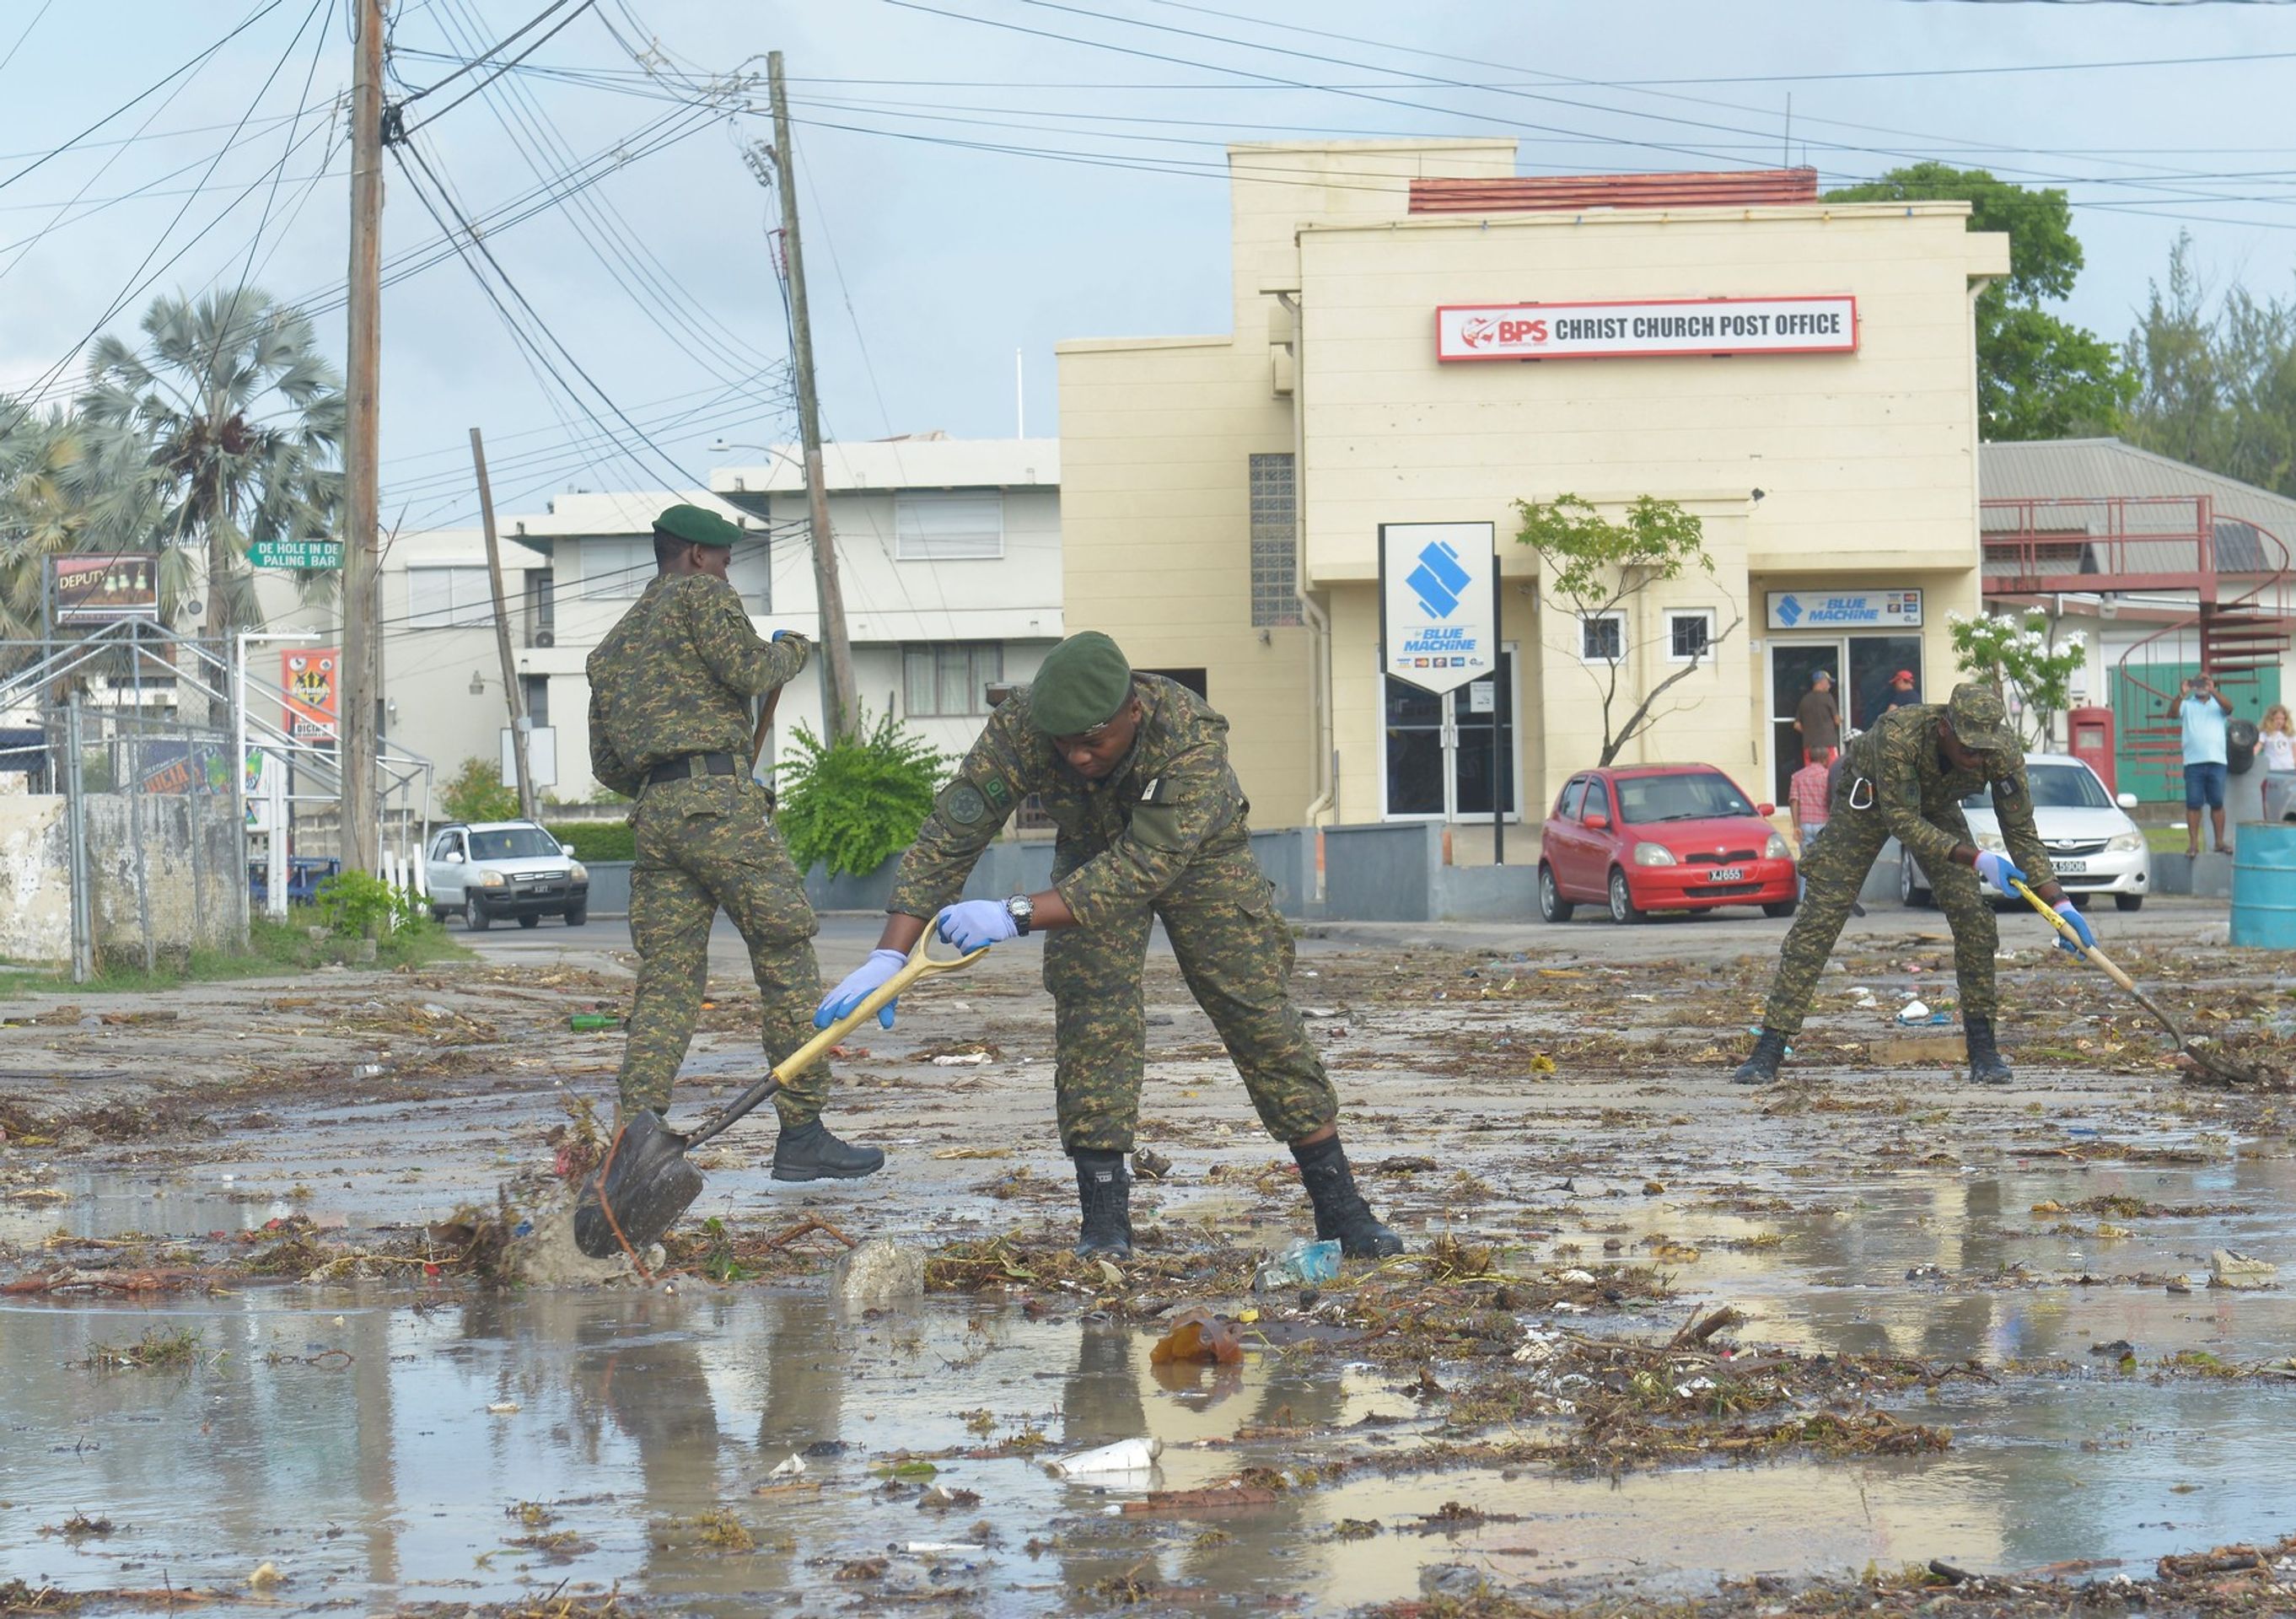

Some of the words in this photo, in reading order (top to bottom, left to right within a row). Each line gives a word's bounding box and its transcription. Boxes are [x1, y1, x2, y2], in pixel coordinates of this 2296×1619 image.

[1498, 320, 1548, 342] BPS
[1556, 318, 1627, 340] CHRIST
[1633, 316, 1714, 337] CHURCH
[1720, 315, 1770, 336] POST
[1776, 314, 1841, 335] OFFICE
[259, 543, 274, 554] DE
[277, 543, 305, 554] HOLE
[309, 544, 320, 554] IN
[324, 544, 338, 554] DE
[264, 556, 305, 567] PALING
[310, 556, 336, 567] BAR
[1826, 598, 1867, 609] BLUE
[1423, 628, 1463, 639] BLUE
[1712, 869, 1740, 880] XJ655
